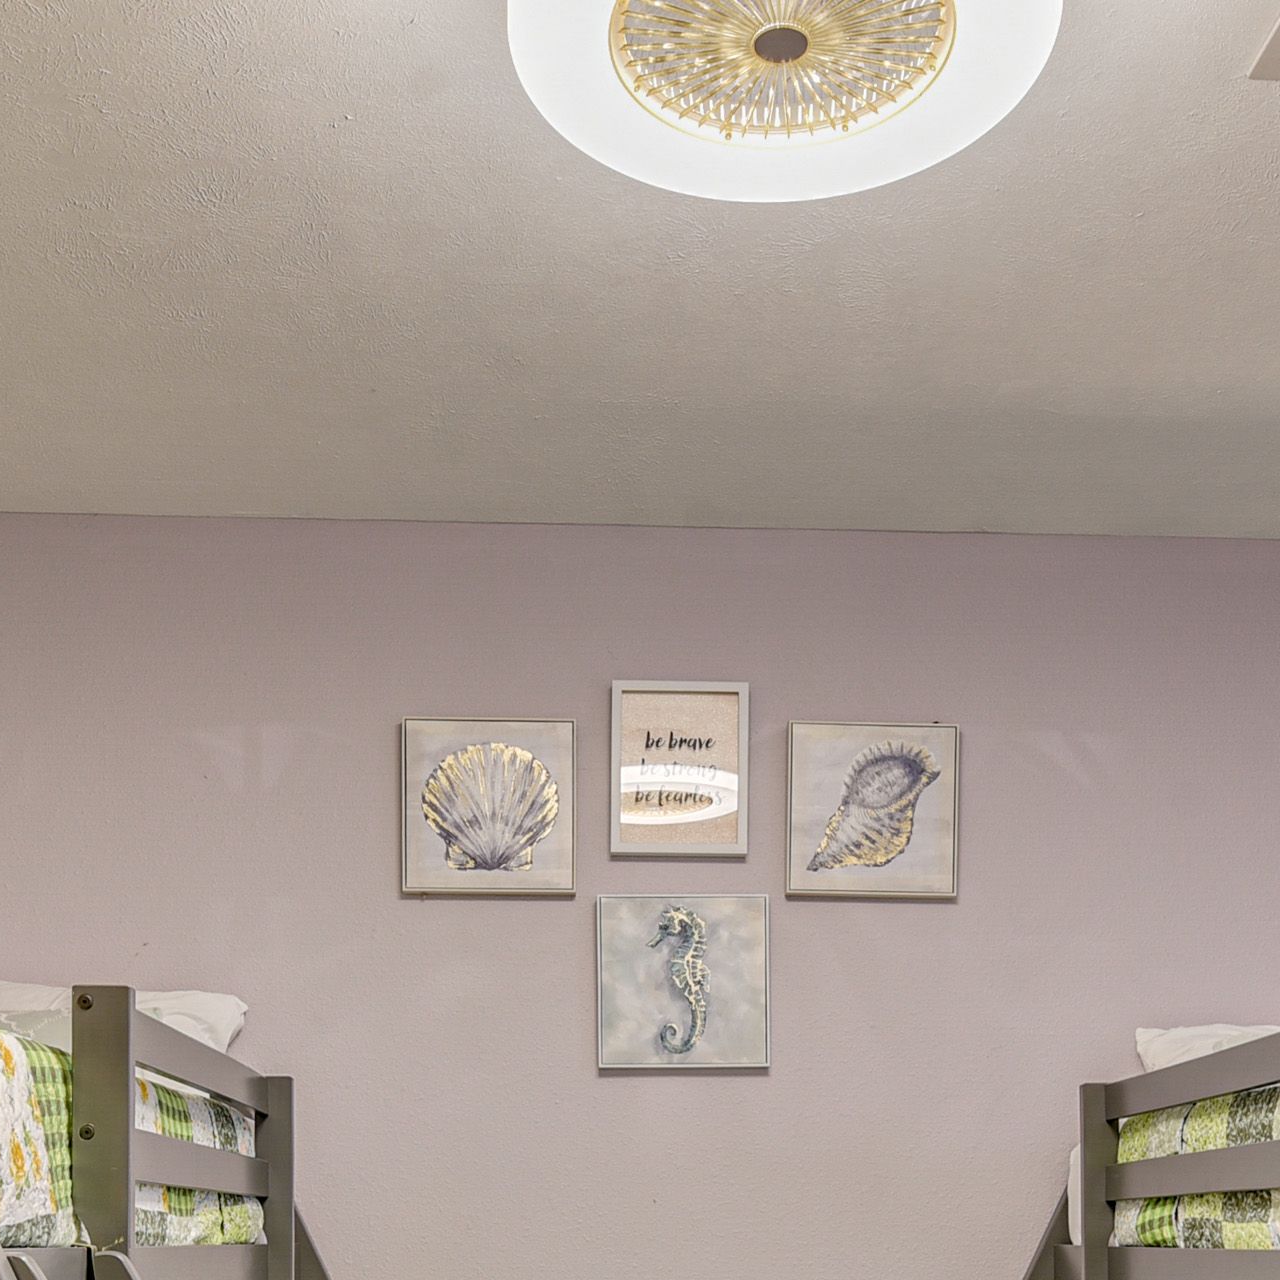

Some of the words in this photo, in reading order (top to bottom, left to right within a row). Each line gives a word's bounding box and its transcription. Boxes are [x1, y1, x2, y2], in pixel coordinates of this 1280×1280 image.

[645, 730, 665, 749] be
[668, 731, 716, 751] brave
[634, 784, 656, 803] be
